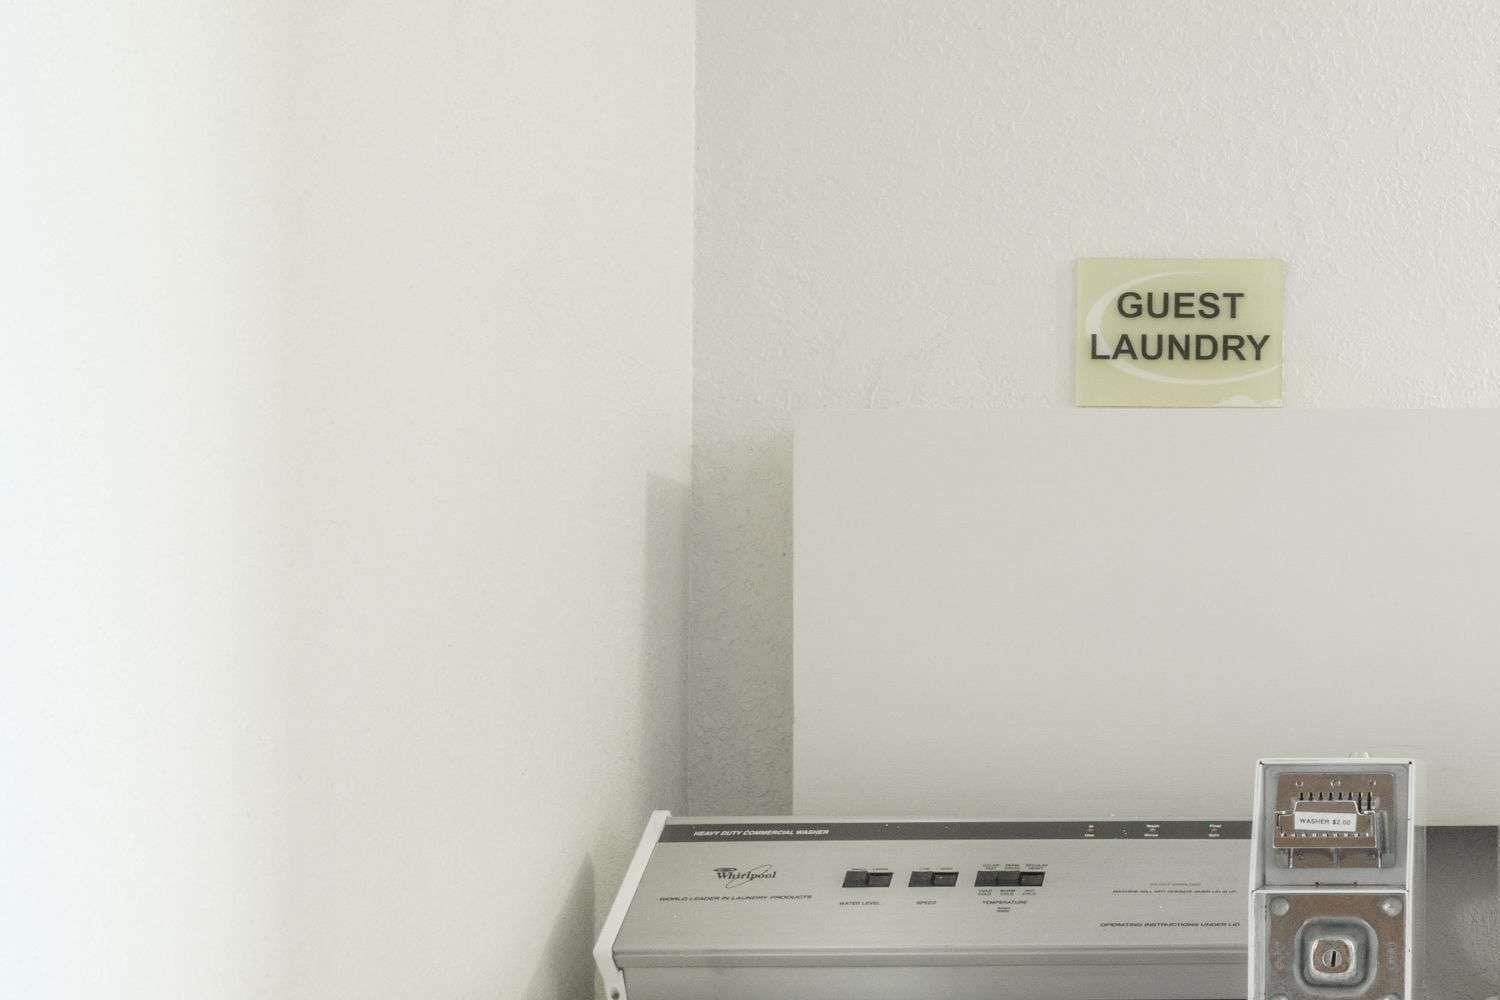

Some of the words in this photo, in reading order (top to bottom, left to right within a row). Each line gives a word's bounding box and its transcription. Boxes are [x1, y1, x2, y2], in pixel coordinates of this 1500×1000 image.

[1117, 291, 1245, 319] GUEST
[1091, 334, 1271, 361] LAUNDRY
[713, 866, 777, 882] Whirlpool
